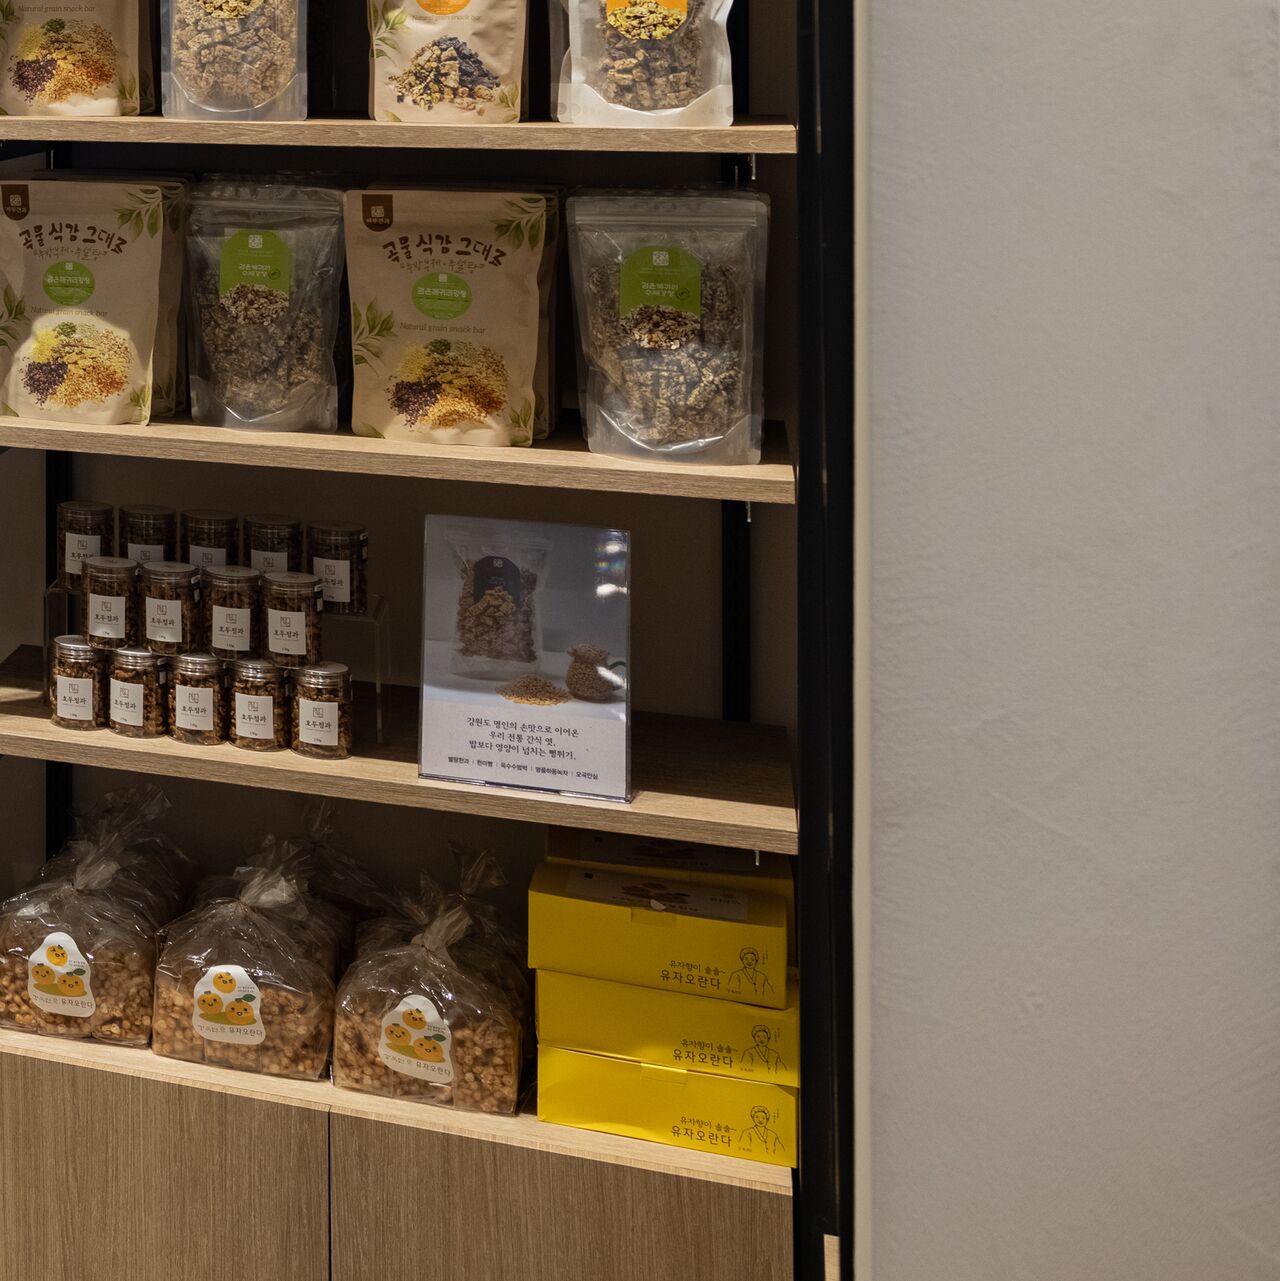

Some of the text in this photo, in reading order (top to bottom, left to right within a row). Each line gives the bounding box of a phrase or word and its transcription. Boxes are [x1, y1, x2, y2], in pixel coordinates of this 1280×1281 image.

[19, 222, 127, 254] 곡물 식감 그대로
[382, 234, 507, 267] 곡물 식감 그대로
[61, 696, 86, 706] 호두정과
[242, 713, 267, 723] 호두정과
[305, 719, 331, 729] 호두정과
[467, 717, 580, 738] 강원도 명인의 손맛으로 이어온
[489, 731, 505, 741] 우리
[508, 732, 524, 744] 전통
[527, 734, 543, 746] 간식
[469, 740, 493, 751] 밥보다
[495, 742, 519, 755] 영양이
[522, 745, 546, 757] 넘치는
[660, 969, 721, 990] 유자오란다
[61, 998, 93, 1010] 유자오란다
[229, 1027, 263, 1038] 유자오란다
[672, 1048, 734, 1069] 유자오란다
[416, 1060, 451, 1076] 유자오란다
[671, 1125, 732, 1148] 유자오란다
